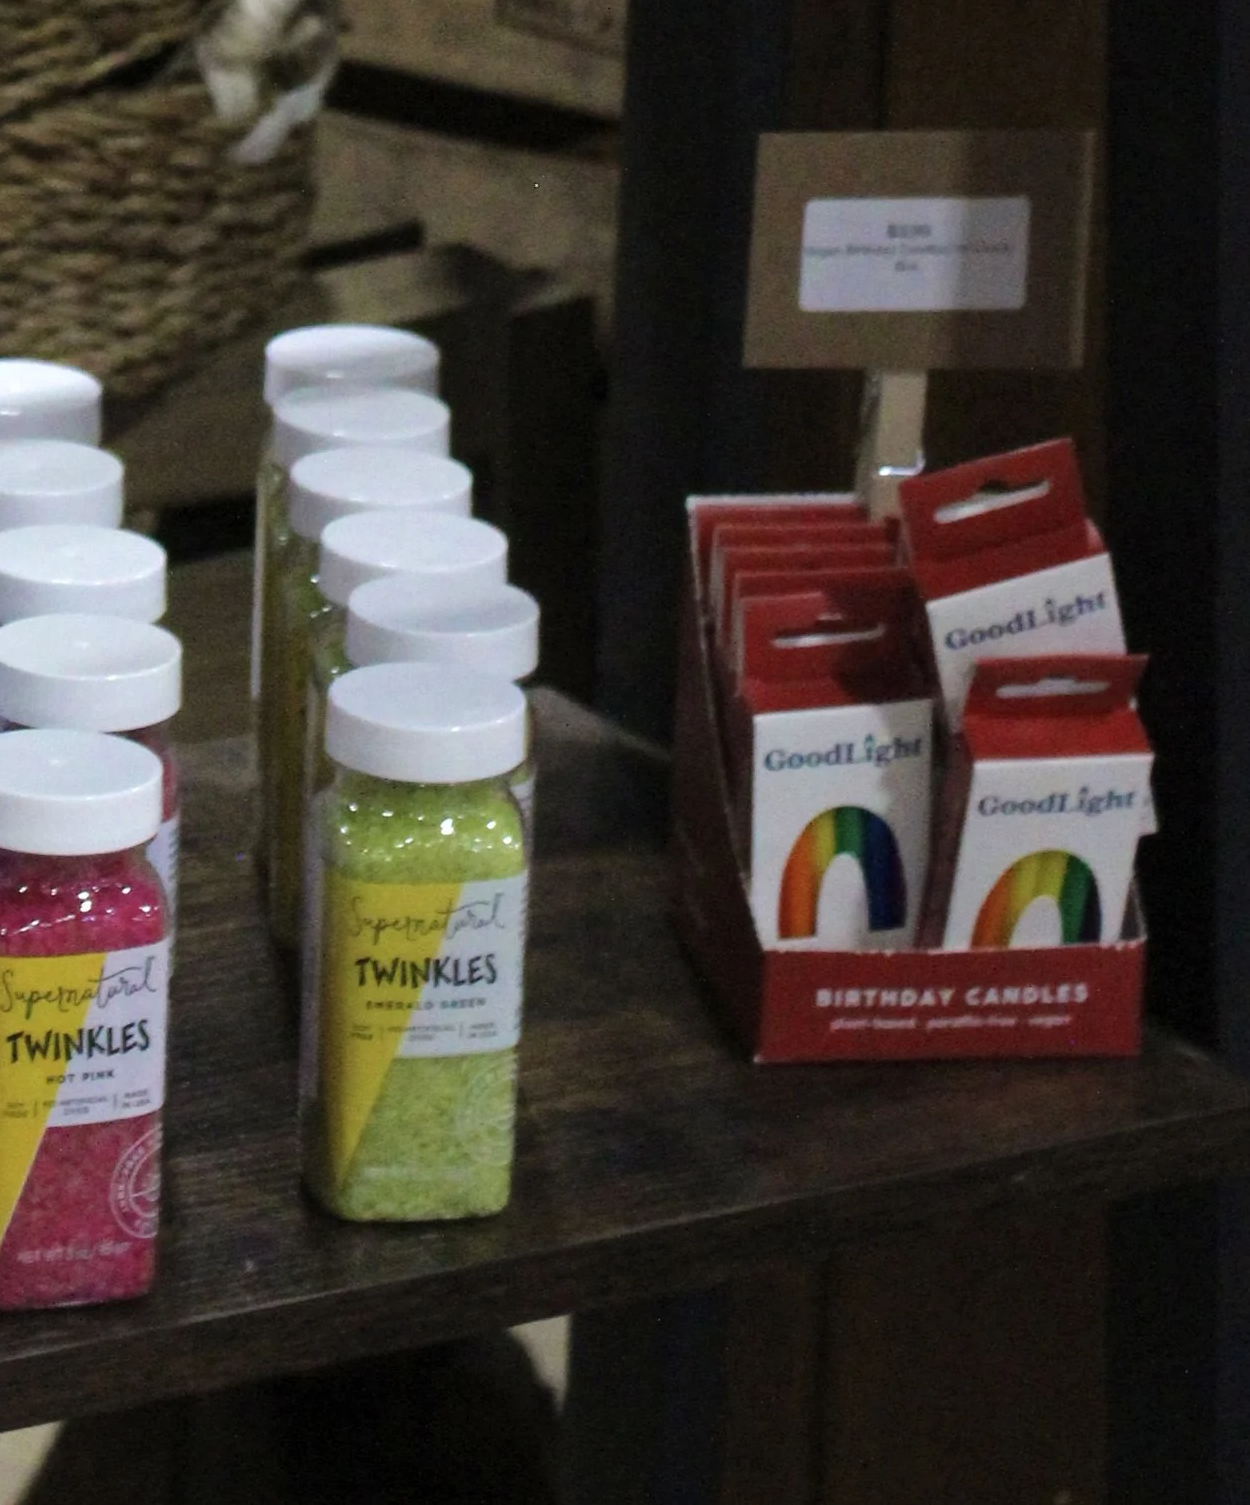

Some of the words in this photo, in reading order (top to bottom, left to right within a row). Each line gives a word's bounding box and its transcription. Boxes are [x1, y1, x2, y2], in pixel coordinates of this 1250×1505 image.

[943, 592, 1107, 650] GoodLight
[764, 733, 923, 772] GoodLight
[978, 786, 1139, 818] GoodLight
[0, 956, 157, 1020] Supernatural
[354, 953, 497, 989] TWINKLES
[815, 987, 955, 1007] BIRTHDAY
[965, 983, 1088, 1006] CANDLES
[6, 1019, 150, 1064] TWINKLES
[46, 1074, 75, 1084] HOT
[81, 1069, 115, 1081] PINK
